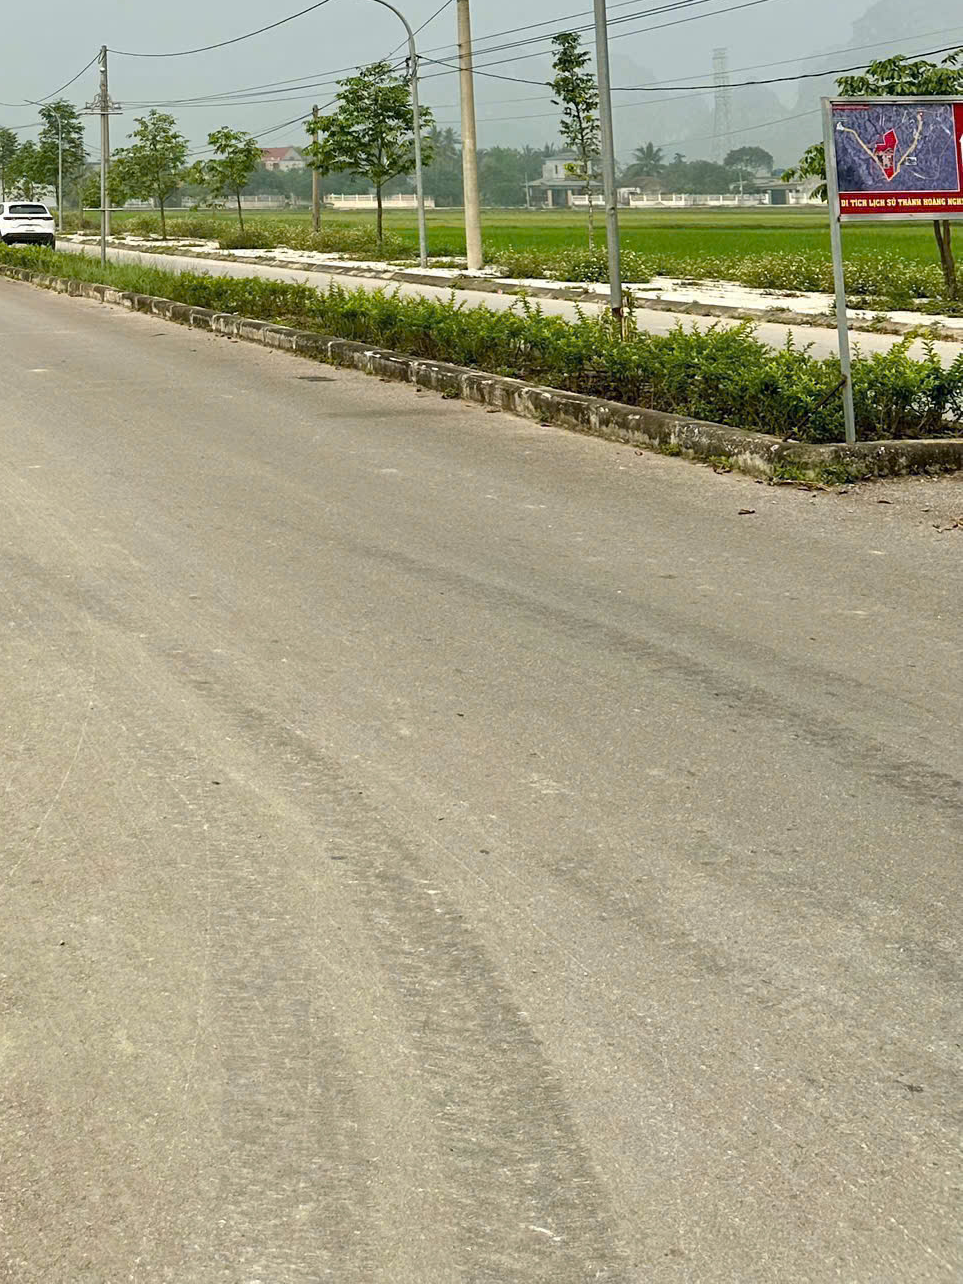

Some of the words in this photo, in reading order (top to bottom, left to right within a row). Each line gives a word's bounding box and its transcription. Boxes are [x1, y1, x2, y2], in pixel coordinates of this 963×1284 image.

[841, 199, 849, 207] DI
[850, 198, 867, 207] TÍCH
[868, 199, 886, 208] LỊCH
